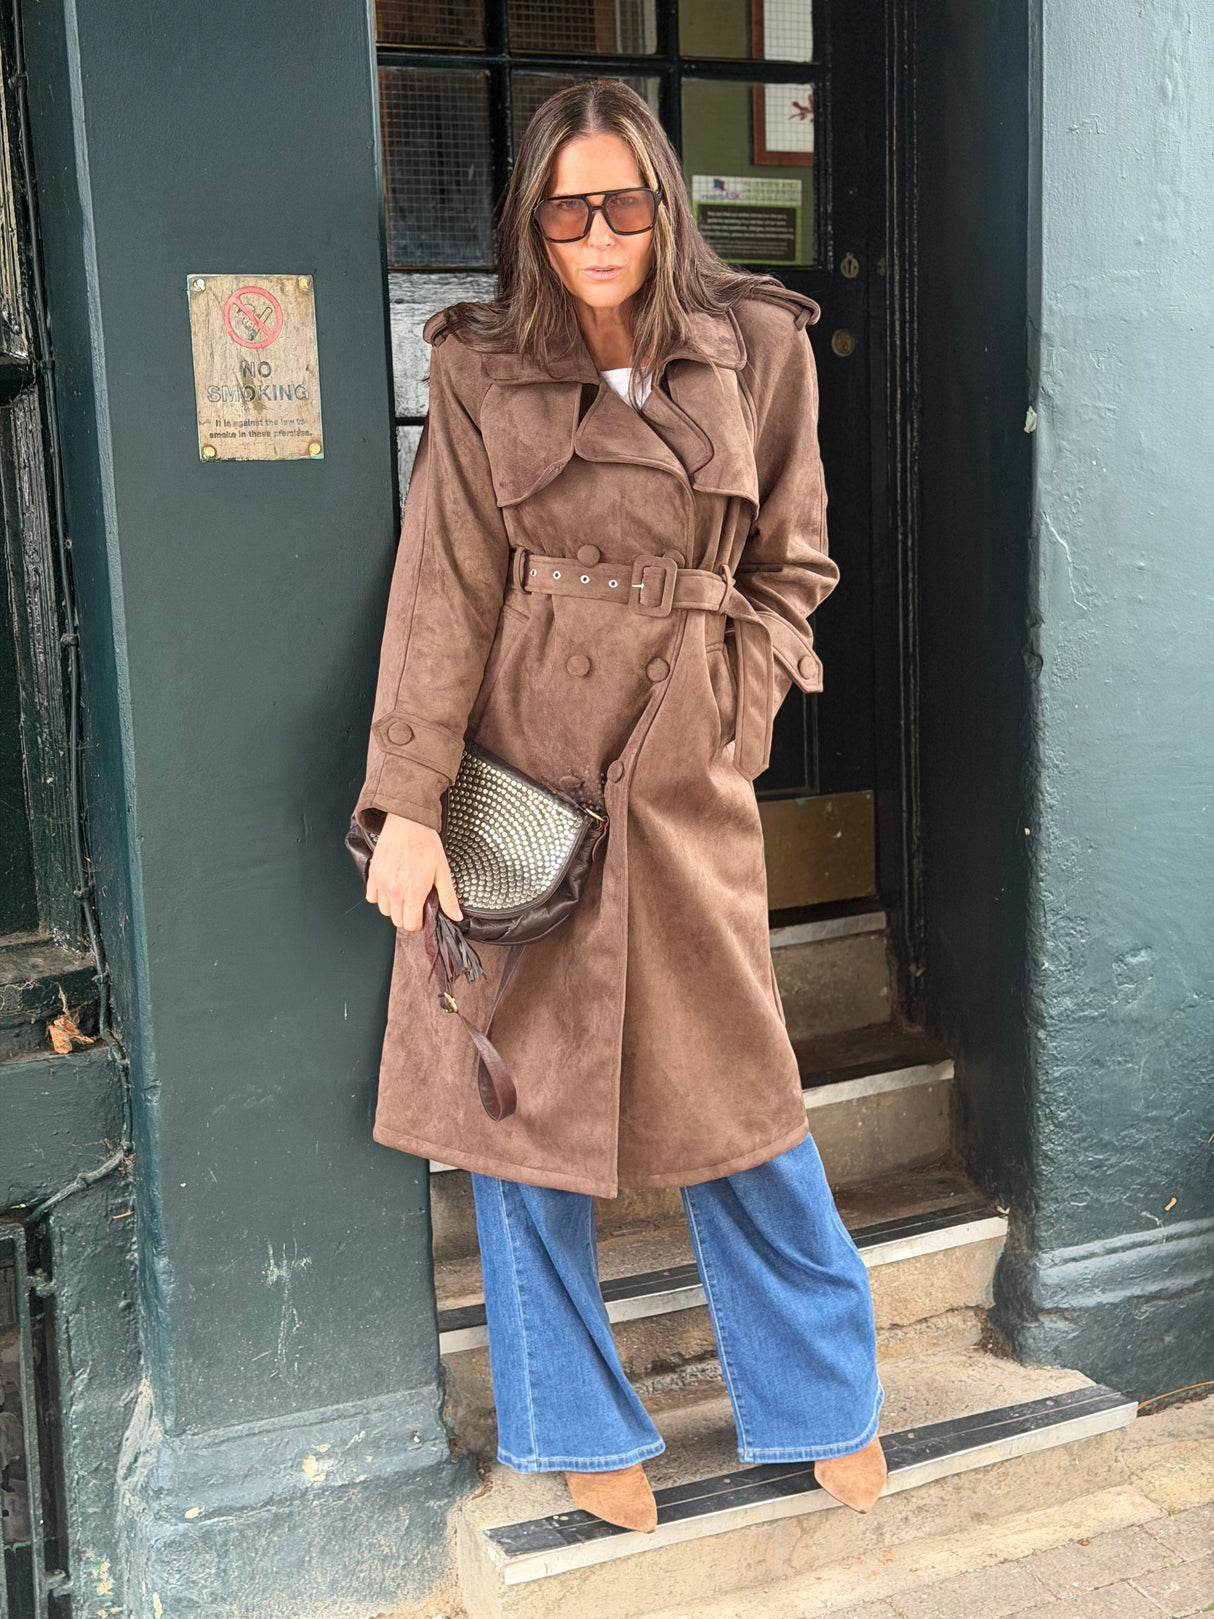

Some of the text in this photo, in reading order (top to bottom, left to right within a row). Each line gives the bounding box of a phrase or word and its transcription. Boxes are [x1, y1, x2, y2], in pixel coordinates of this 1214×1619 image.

[242, 360, 272, 378] NO
[207, 384, 310, 403] SMOKING
[215, 419, 222, 427] It
[223, 419, 231, 427] is
[232, 419, 263, 428] against
[265, 418, 278, 426] the
[280, 418, 295, 426] law
[209, 431, 237, 439] smoke
[238, 430, 247, 438] in
[248, 430, 271, 438] these
